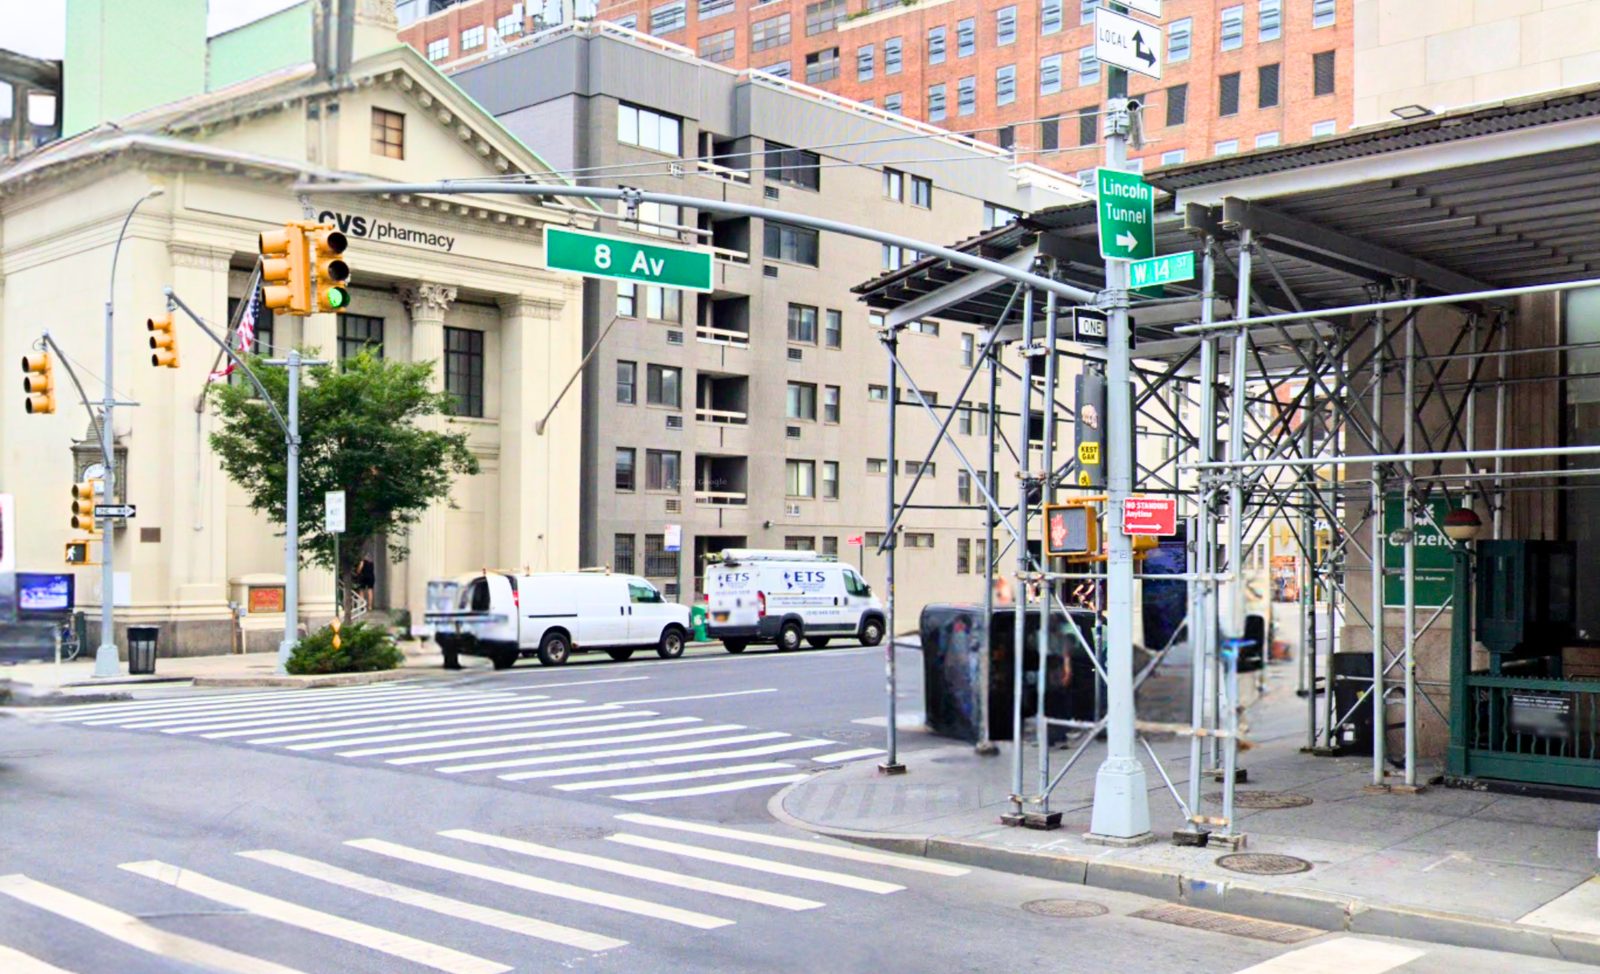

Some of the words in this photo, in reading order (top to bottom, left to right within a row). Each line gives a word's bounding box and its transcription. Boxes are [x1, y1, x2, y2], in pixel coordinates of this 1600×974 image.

[1100, 27, 1128, 49] LOCAL
[1103, 177, 1148, 200] Lincoln
[1105, 202, 1146, 224] Tunnel
[594, 243, 612, 269] 8
[630, 249, 665, 277] Av
[1133, 263, 1147, 285] W
[1154, 259, 1170, 281] 14
[1083, 319, 1103, 335] ONE
[1126, 501, 1136, 509] NO
[1137, 502, 1168, 510] STANDING
[1126, 510, 1152, 519] Anytime
[726, 572, 750, 582] ETS
[794, 571, 826, 582] ETS
